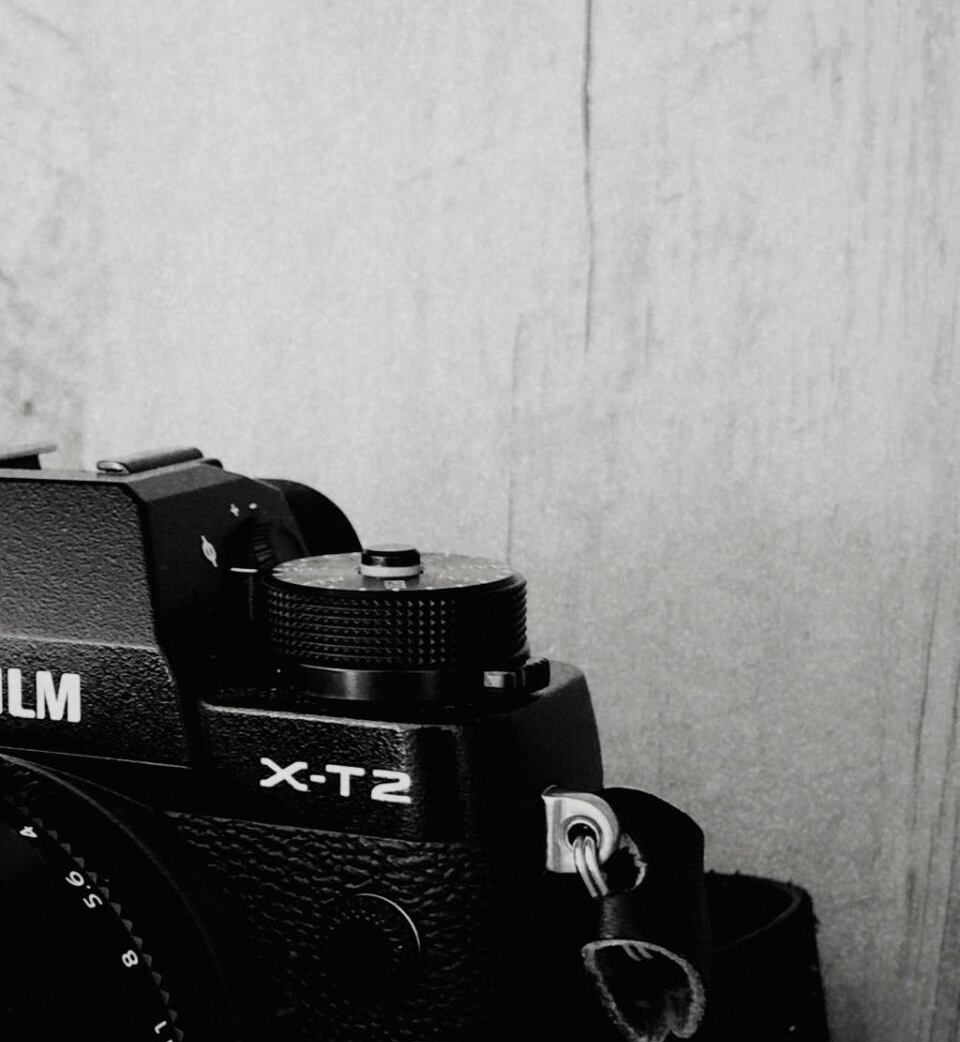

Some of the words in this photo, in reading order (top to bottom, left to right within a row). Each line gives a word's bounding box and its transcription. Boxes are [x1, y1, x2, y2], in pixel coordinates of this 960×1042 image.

[258, 757, 413, 805] X-T2
[18, 824, 39, 840] 4
[120, 949, 141, 969] 8
